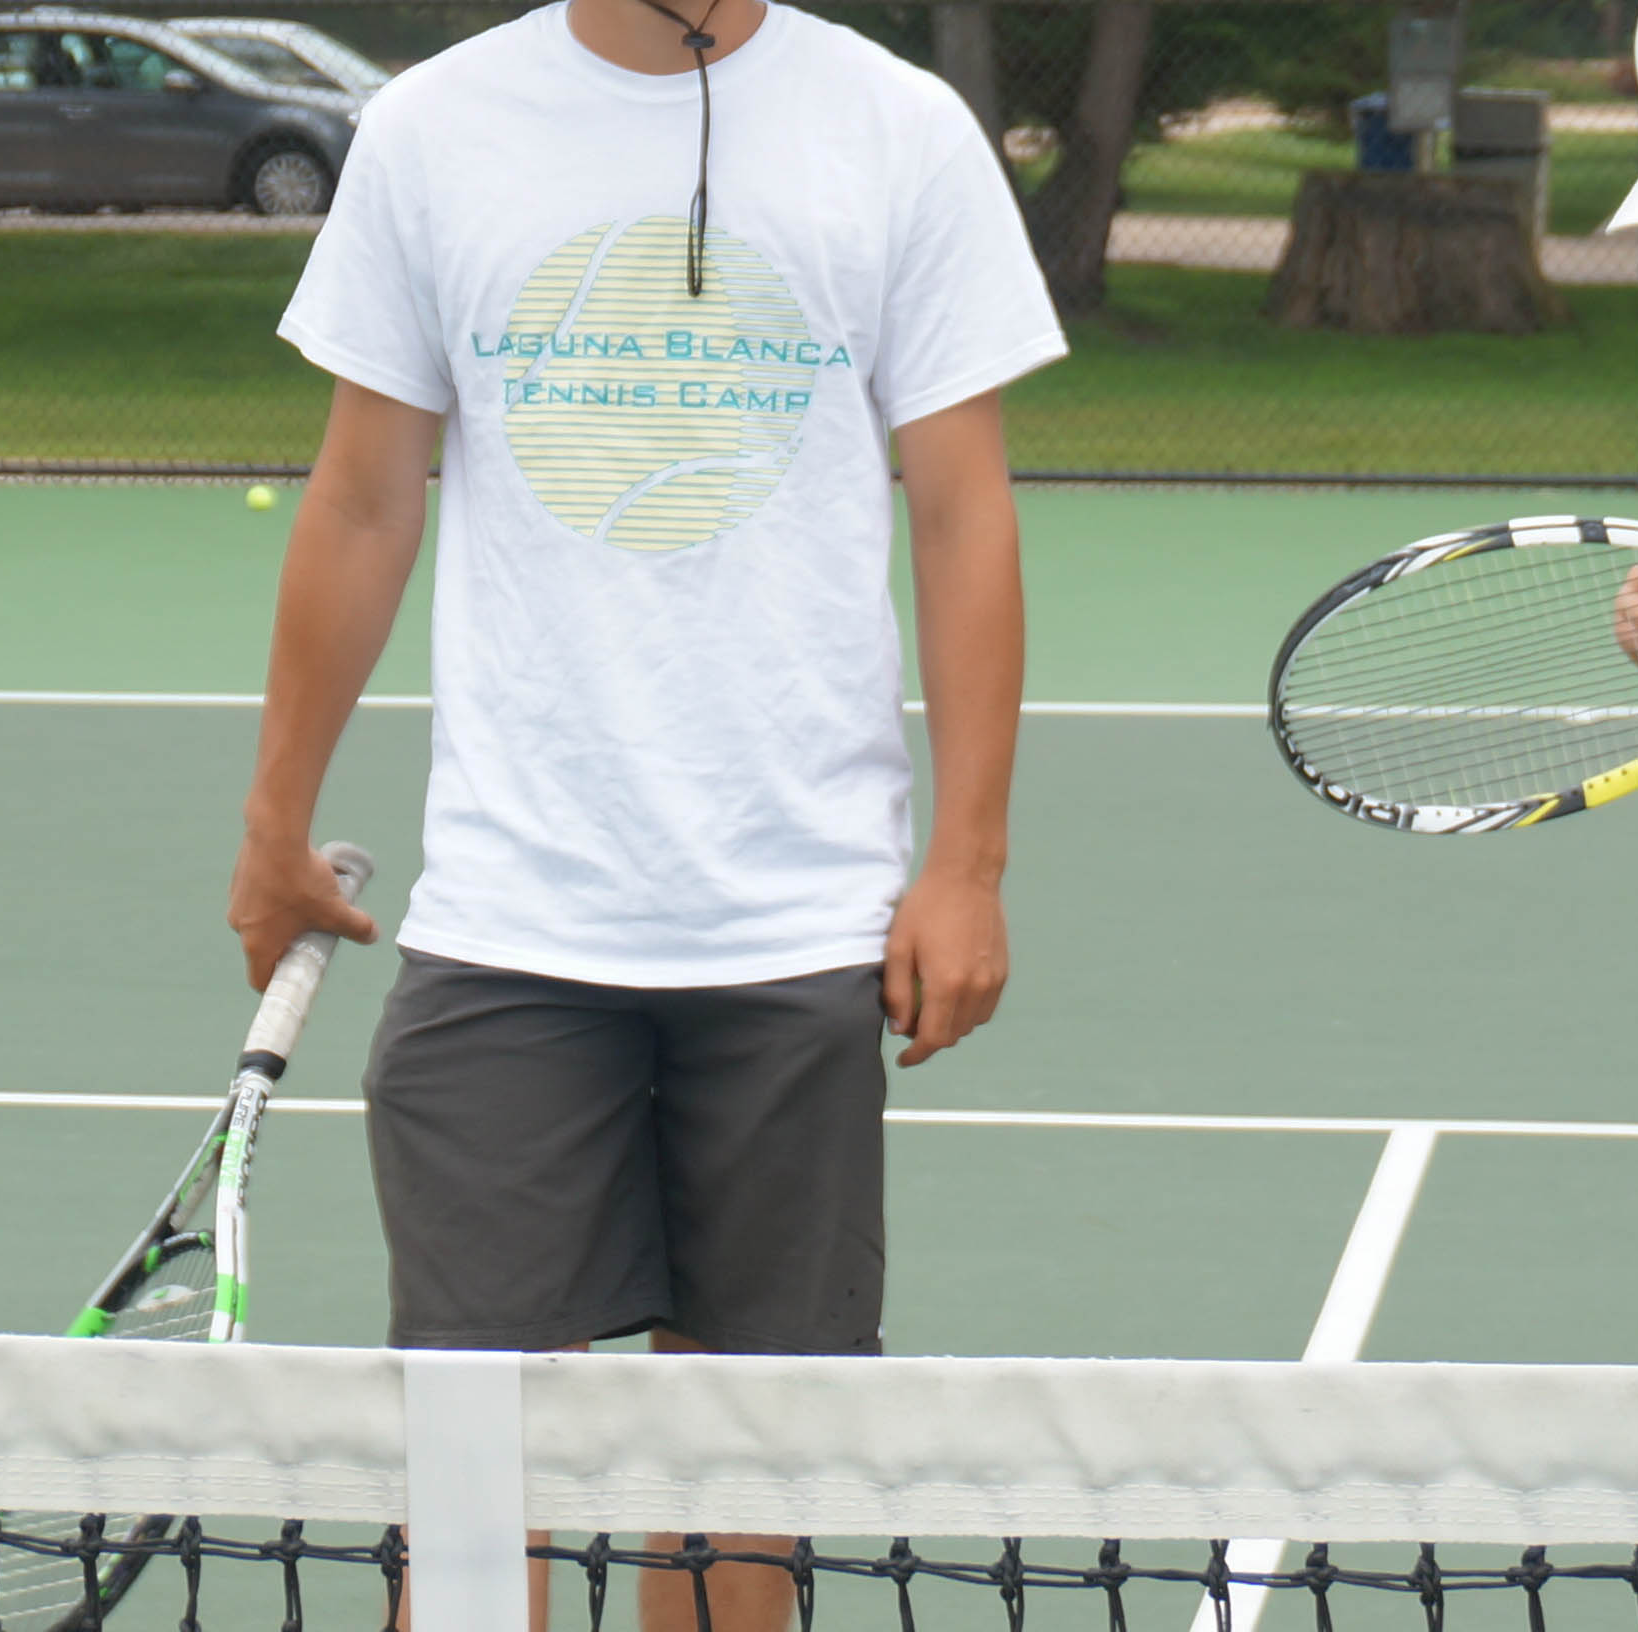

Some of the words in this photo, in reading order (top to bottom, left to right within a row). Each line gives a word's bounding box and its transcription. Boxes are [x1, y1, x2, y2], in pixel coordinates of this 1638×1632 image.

[471, 331, 645, 359] LAGUNA
[665, 330, 852, 367] BLANCA
[504, 378, 656, 407] TENNIS
[678, 381, 811, 413] CAMP
[232, 1085, 255, 1130] PURE
